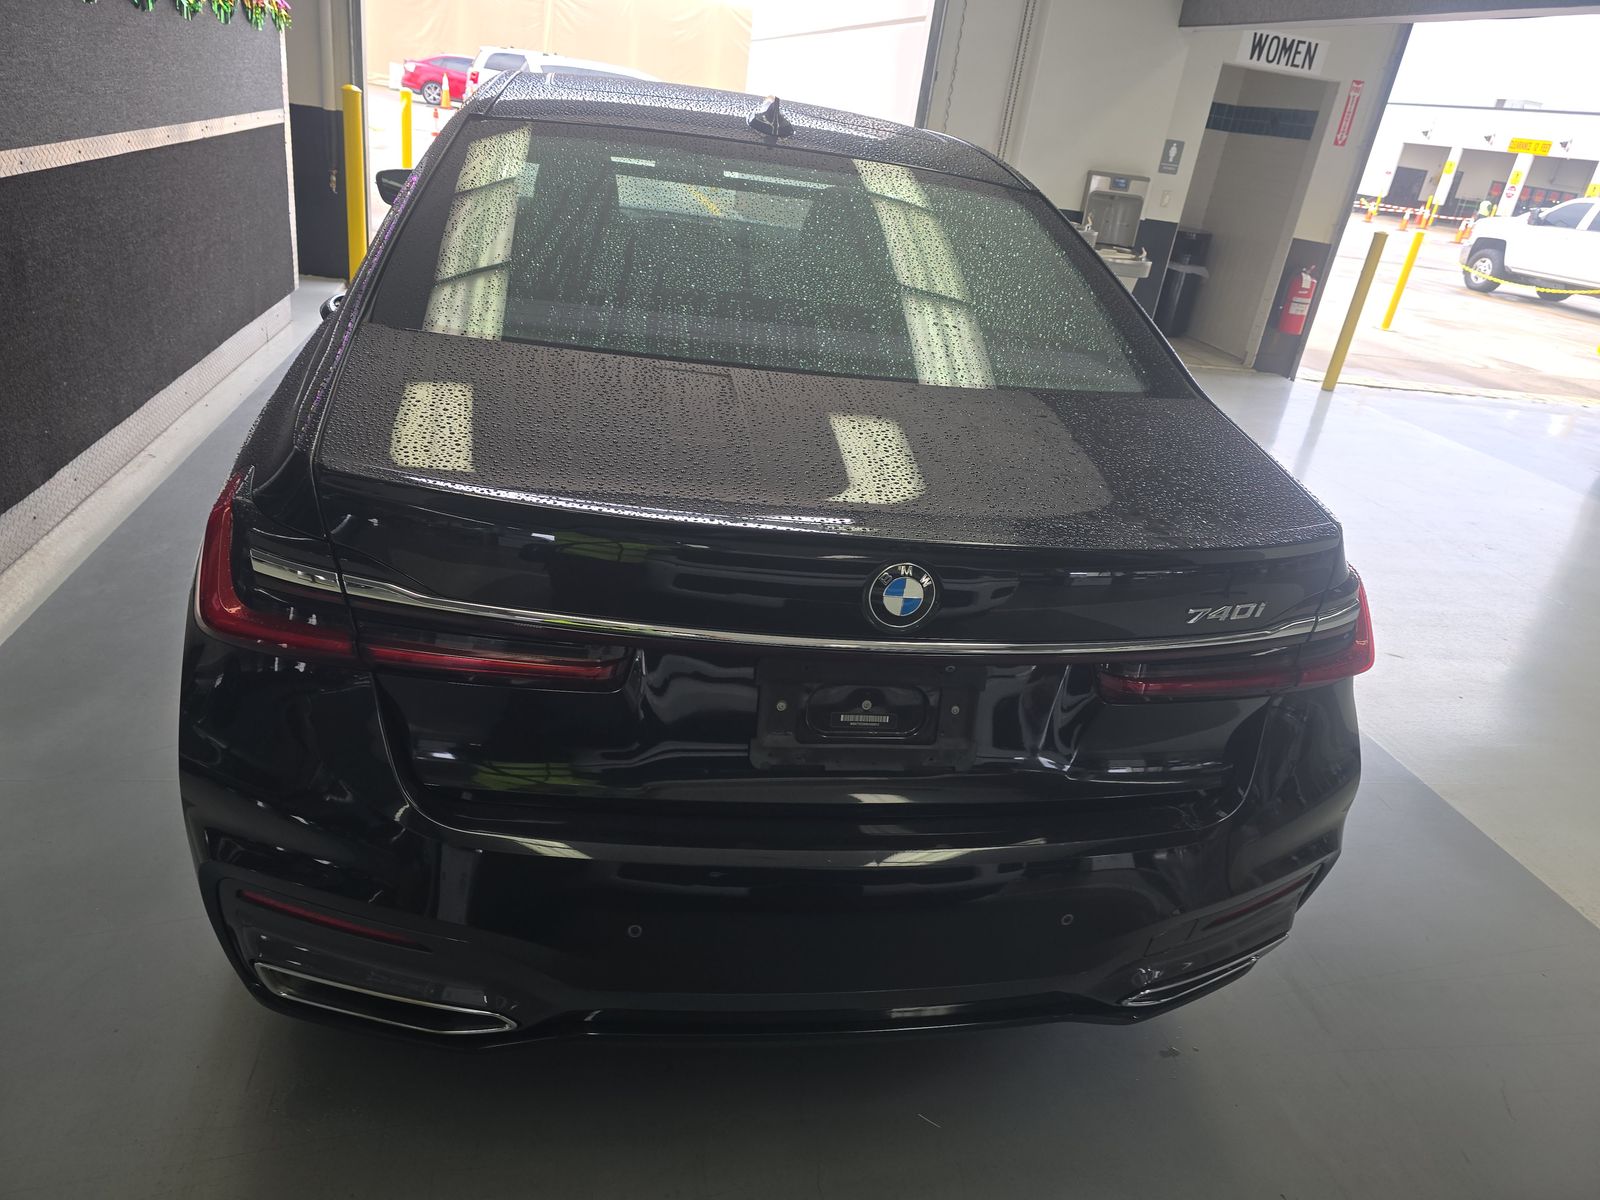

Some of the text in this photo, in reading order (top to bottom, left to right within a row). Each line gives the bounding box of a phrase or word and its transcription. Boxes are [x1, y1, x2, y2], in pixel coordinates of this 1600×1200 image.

[1249, 31, 1319, 71] WOMEN
[880, 565, 932, 588] BMW
[1187, 602, 1266, 624] 740i
